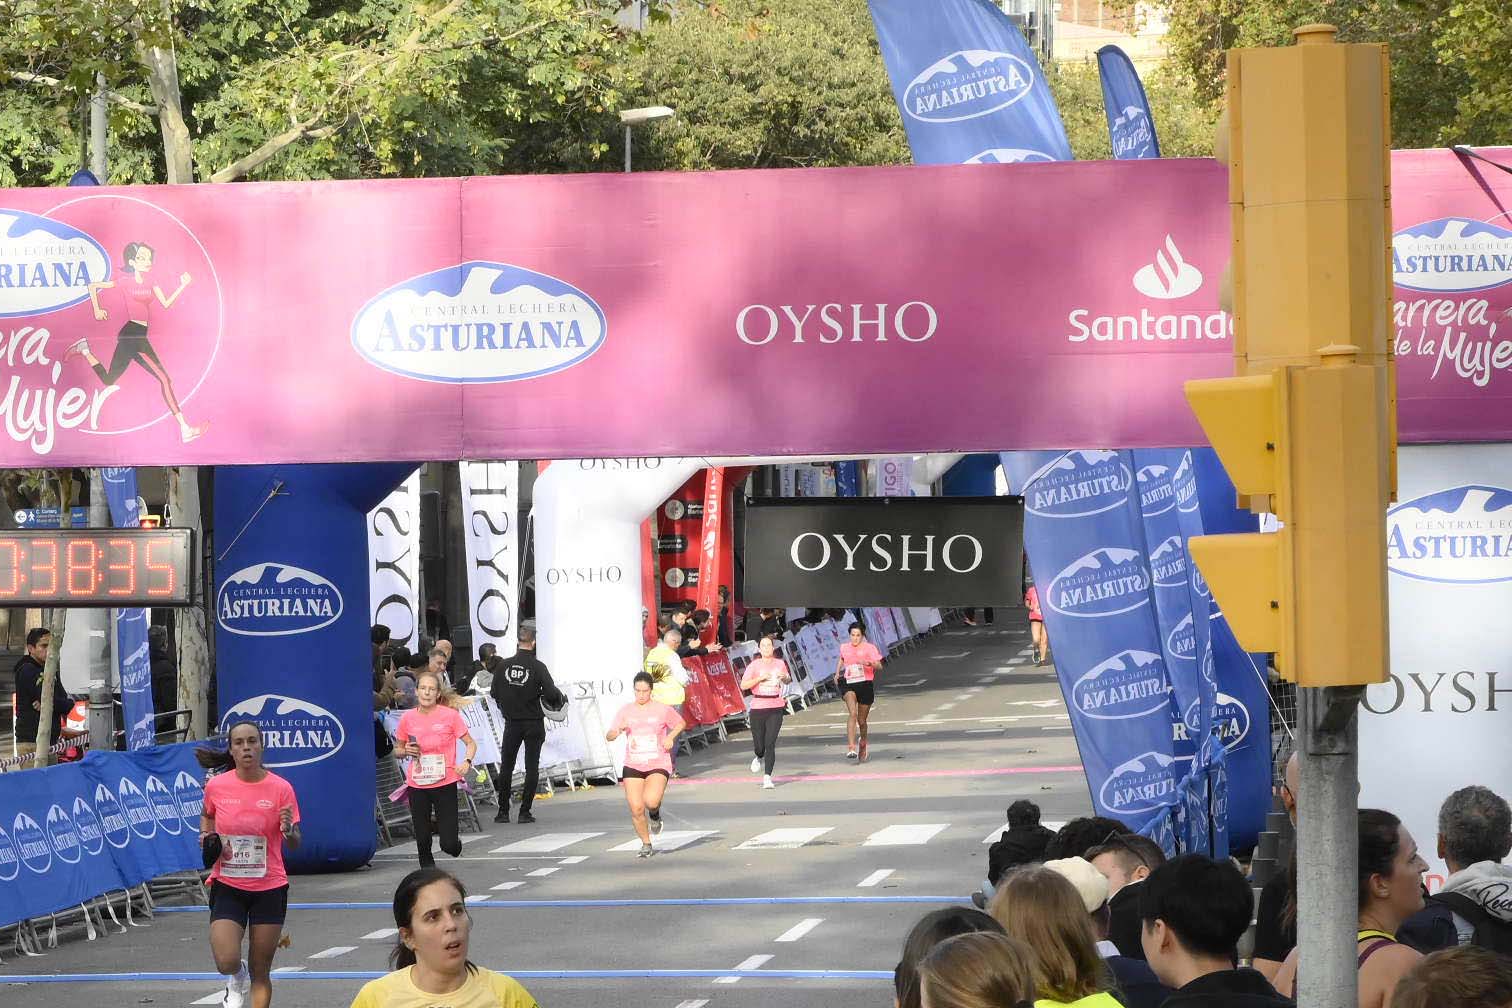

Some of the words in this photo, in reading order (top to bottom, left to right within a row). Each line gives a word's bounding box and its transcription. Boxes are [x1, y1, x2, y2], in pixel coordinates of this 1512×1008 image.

[11, 245, 87, 257] LECHERA
[1463, 240, 1512, 250] LECHER
[496, 302, 578, 315] LECHERA
[735, 301, 939, 345] OYSHO
[1393, 299, 1489, 328] arrera
[372, 308, 587, 352] ASTURIANA
[1068, 309, 1234, 342] Santand
[1417, 328, 1436, 356] la
[1431, 322, 1512, 387] Muje
[1415, 519, 1483, 529] CENTRAL
[790, 532, 983, 573] OYSHO
[1388, 523, 1512, 559] ASTURI
[546, 565, 622, 585] OYSHO
[221, 593, 334, 620] ASTURIANA
[233, 588, 275, 597] CENTRAL
[280, 588, 330, 597] LECHERA
[1359, 671, 1512, 715] OYSH
